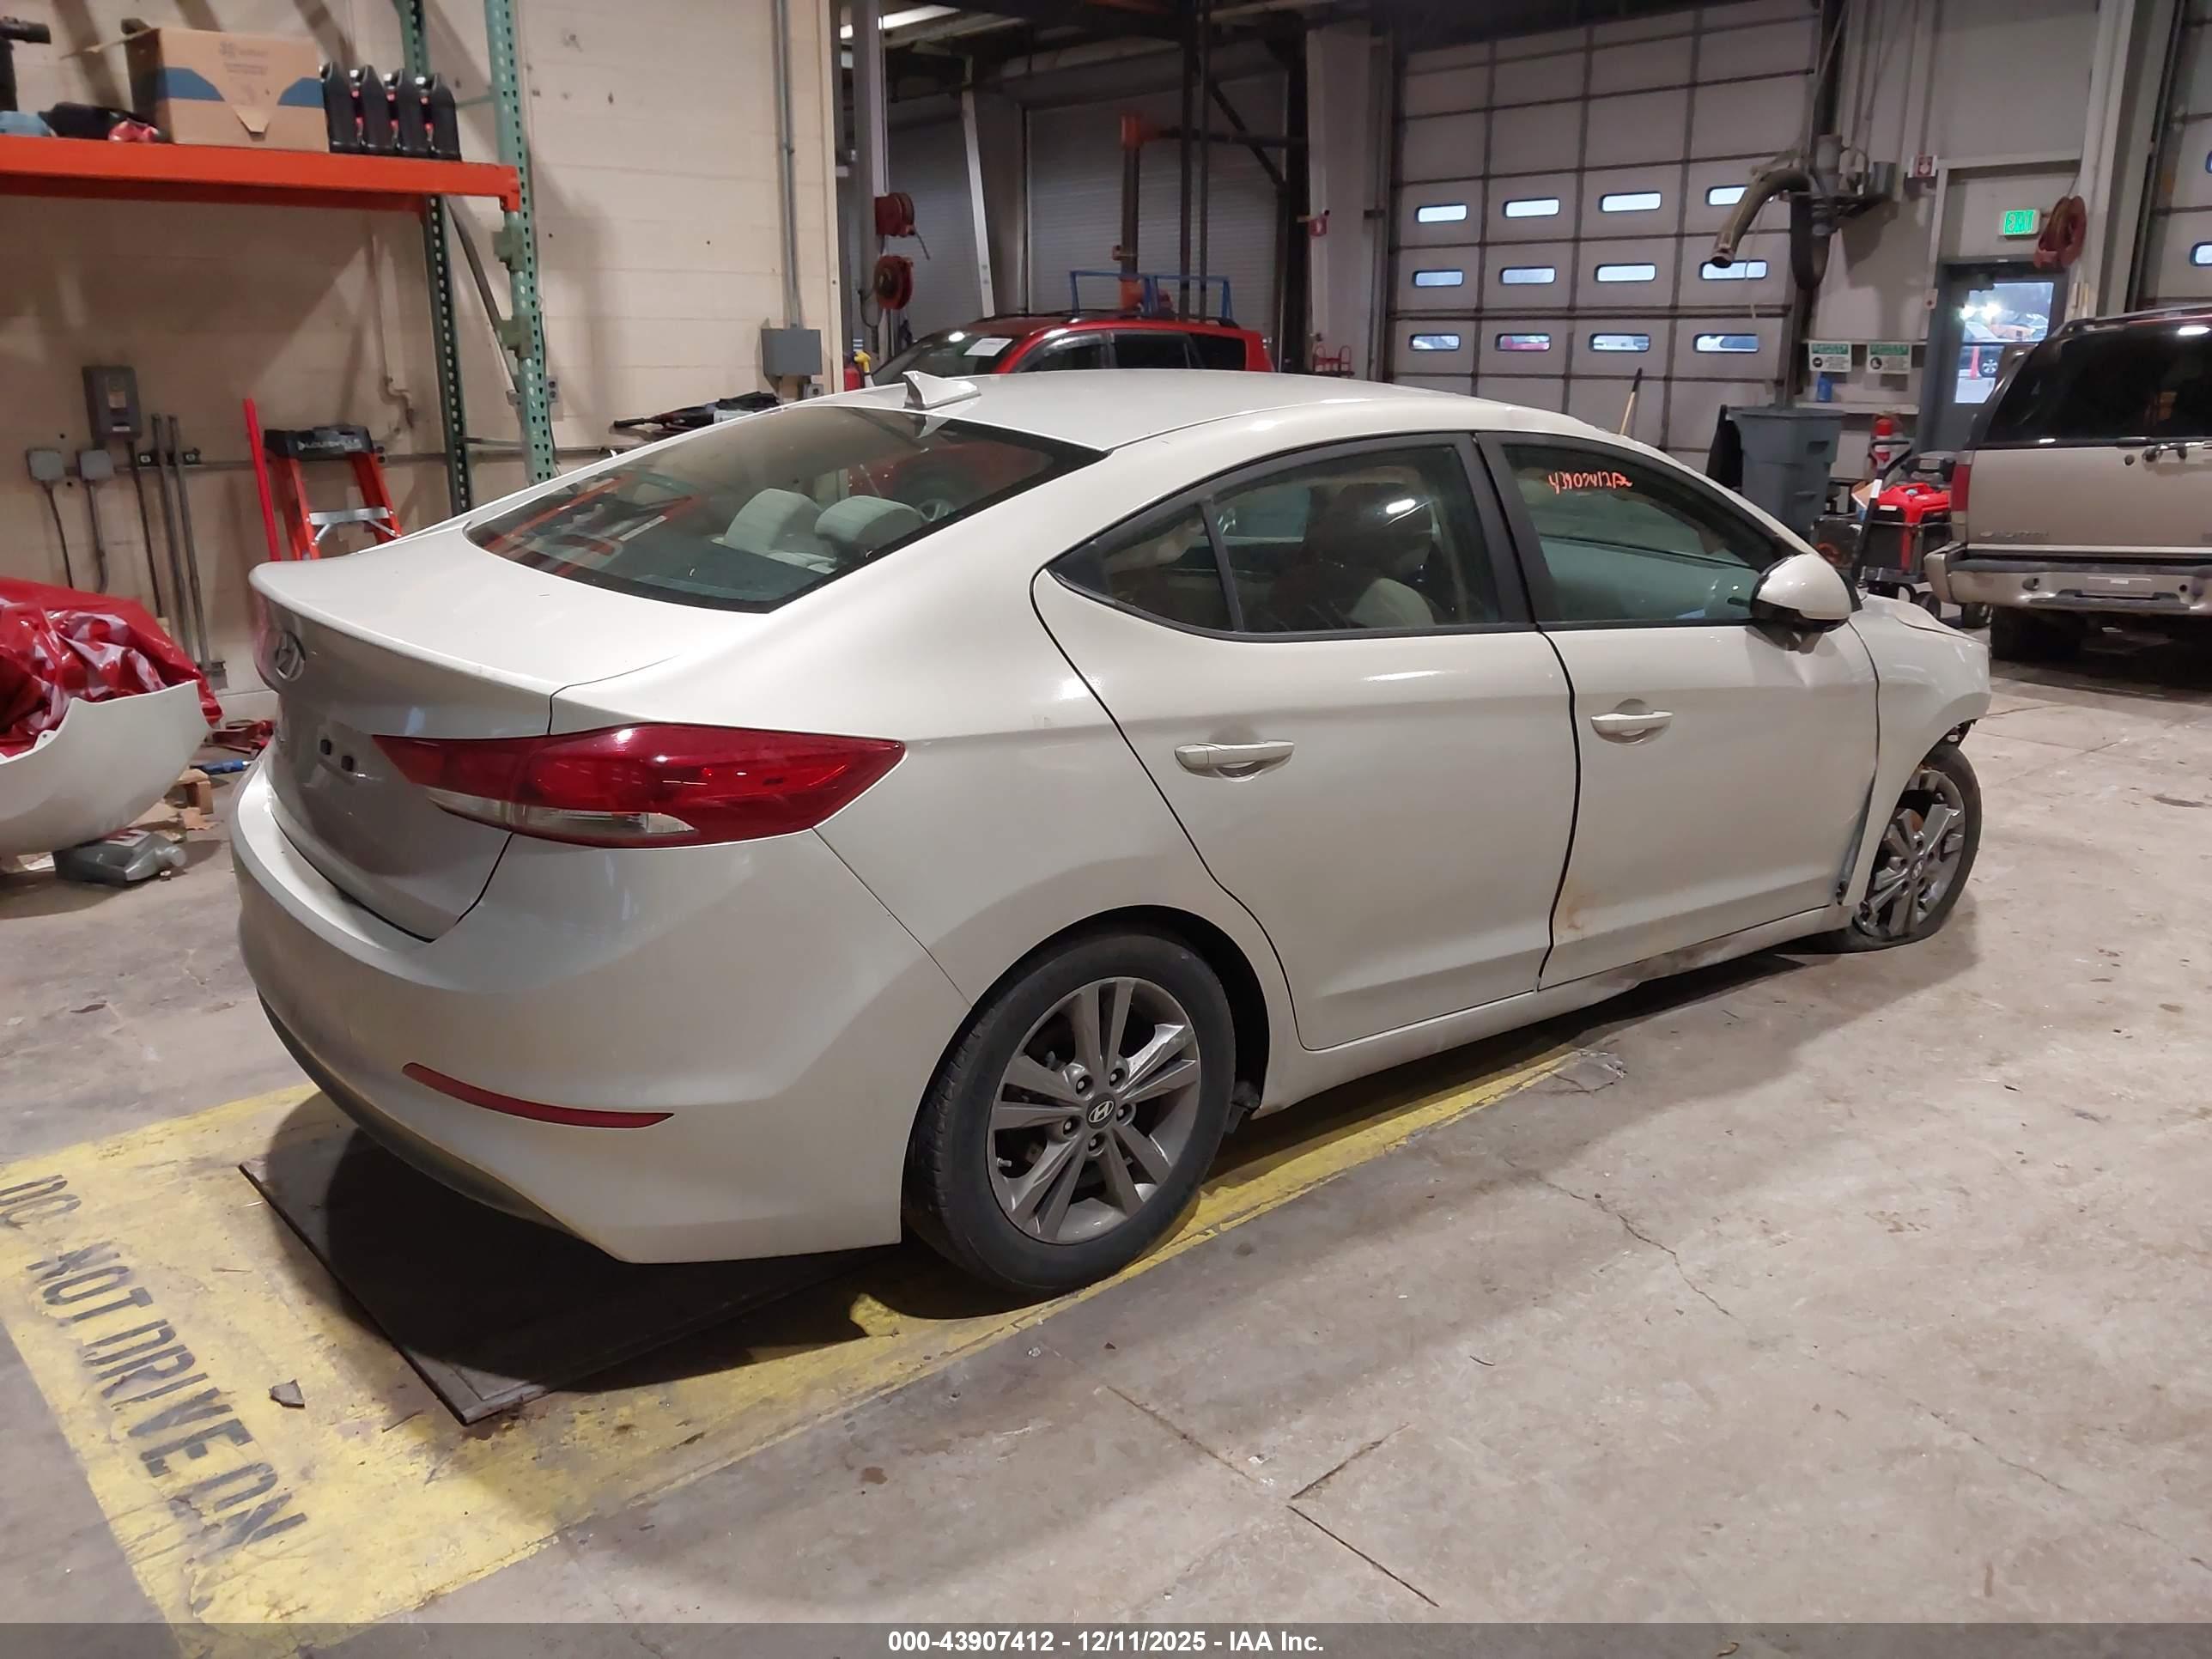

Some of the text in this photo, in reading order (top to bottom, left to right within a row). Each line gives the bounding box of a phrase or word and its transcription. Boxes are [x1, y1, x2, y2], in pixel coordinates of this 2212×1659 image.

[26, 1241, 154, 1327] NOT
[82, 1318, 253, 1478] DRIVE
[172, 1462, 307, 1553] ON
